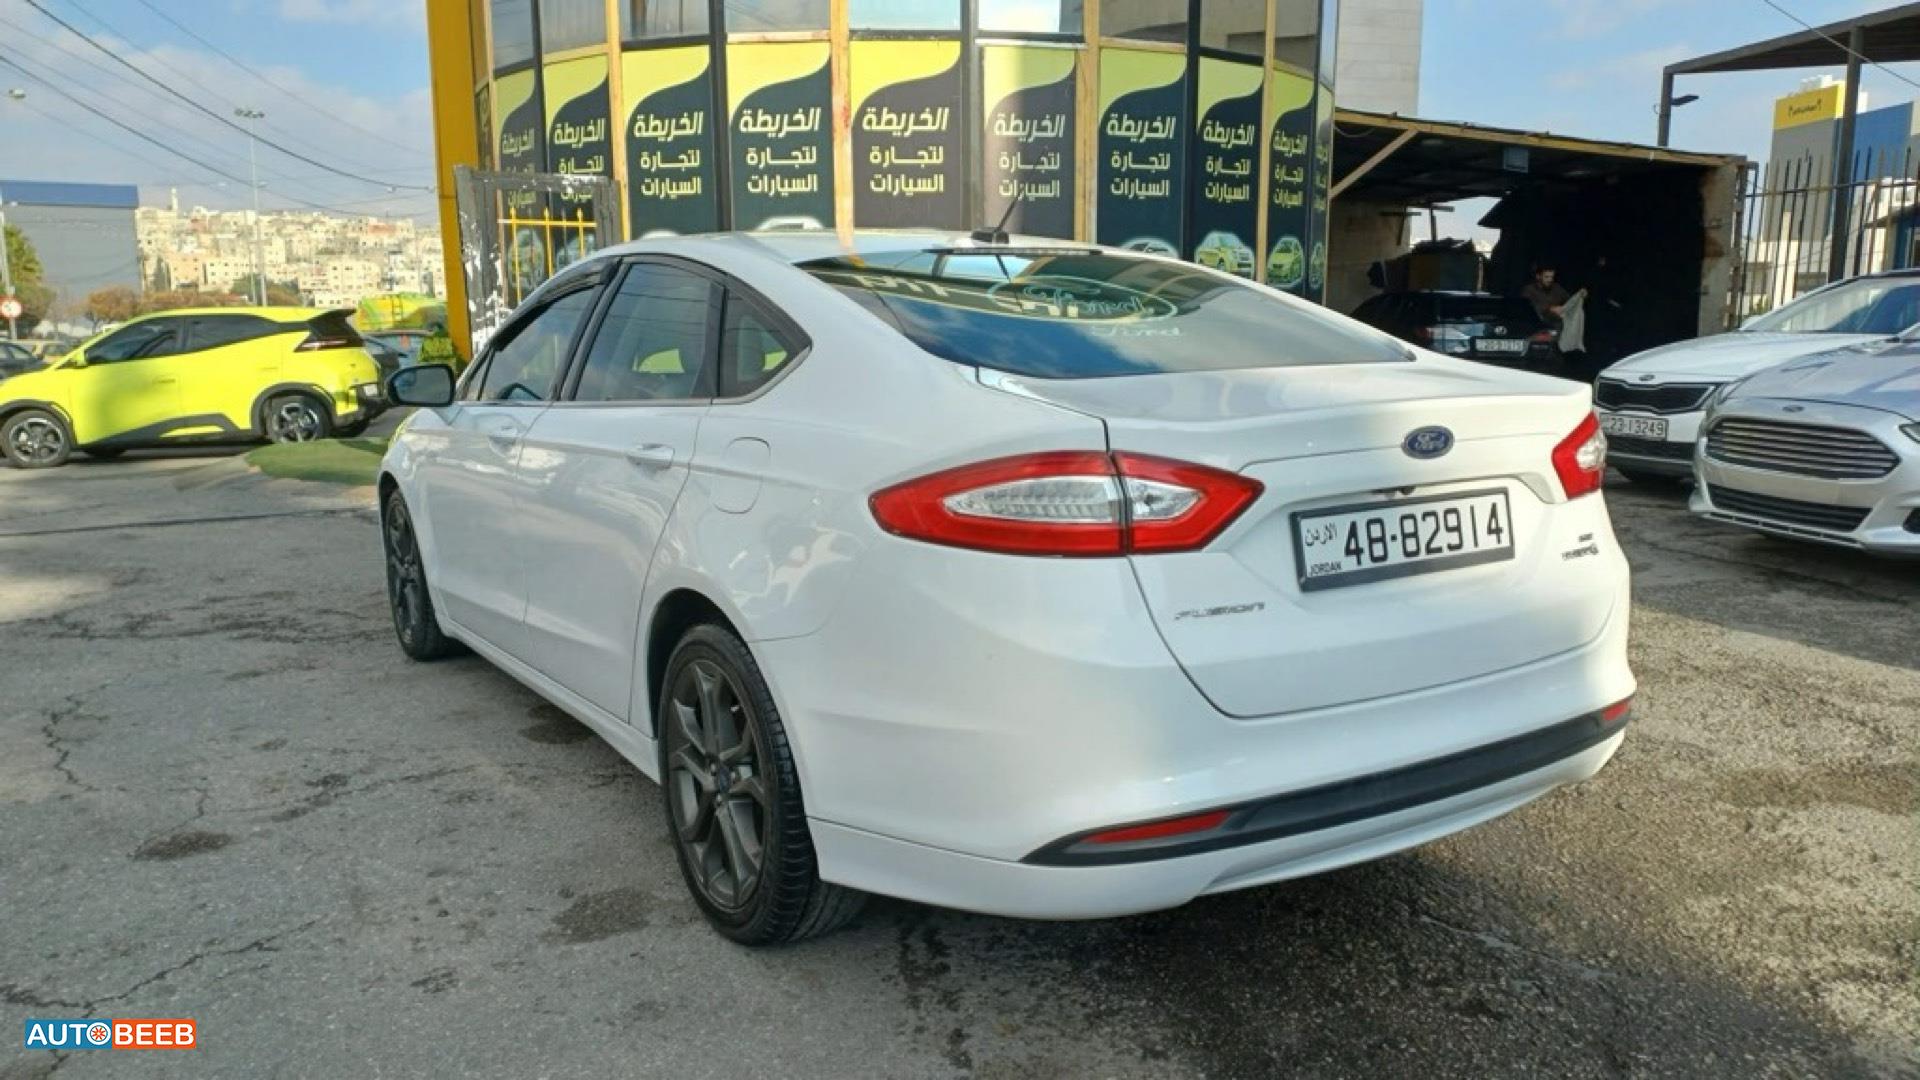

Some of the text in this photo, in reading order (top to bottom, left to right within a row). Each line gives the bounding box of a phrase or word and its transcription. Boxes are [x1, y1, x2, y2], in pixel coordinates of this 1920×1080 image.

[554, 117, 606, 149] الخريطة
[633, 111, 704, 144] الخريطة
[738, 107, 822, 139] الخريطة
[862, 106, 950, 138] الخريطة
[993, 113, 1066, 143] الخريطة
[1106, 113, 1177, 143] الخريطة
[1203, 120, 1255, 149] الخريطة
[640, 175, 702, 200] السيارات
[747, 174, 818, 198] السيارات
[869, 174, 945, 196] السيارات
[999, 179, 1061, 201] السيارات
[1110, 178, 1171, 199] السيارات
[1205, 182, 1250, 204] السيارات
[1344, 502, 1503, 566] 48-82914
[1310, 561, 1342, 577] JORDAN
